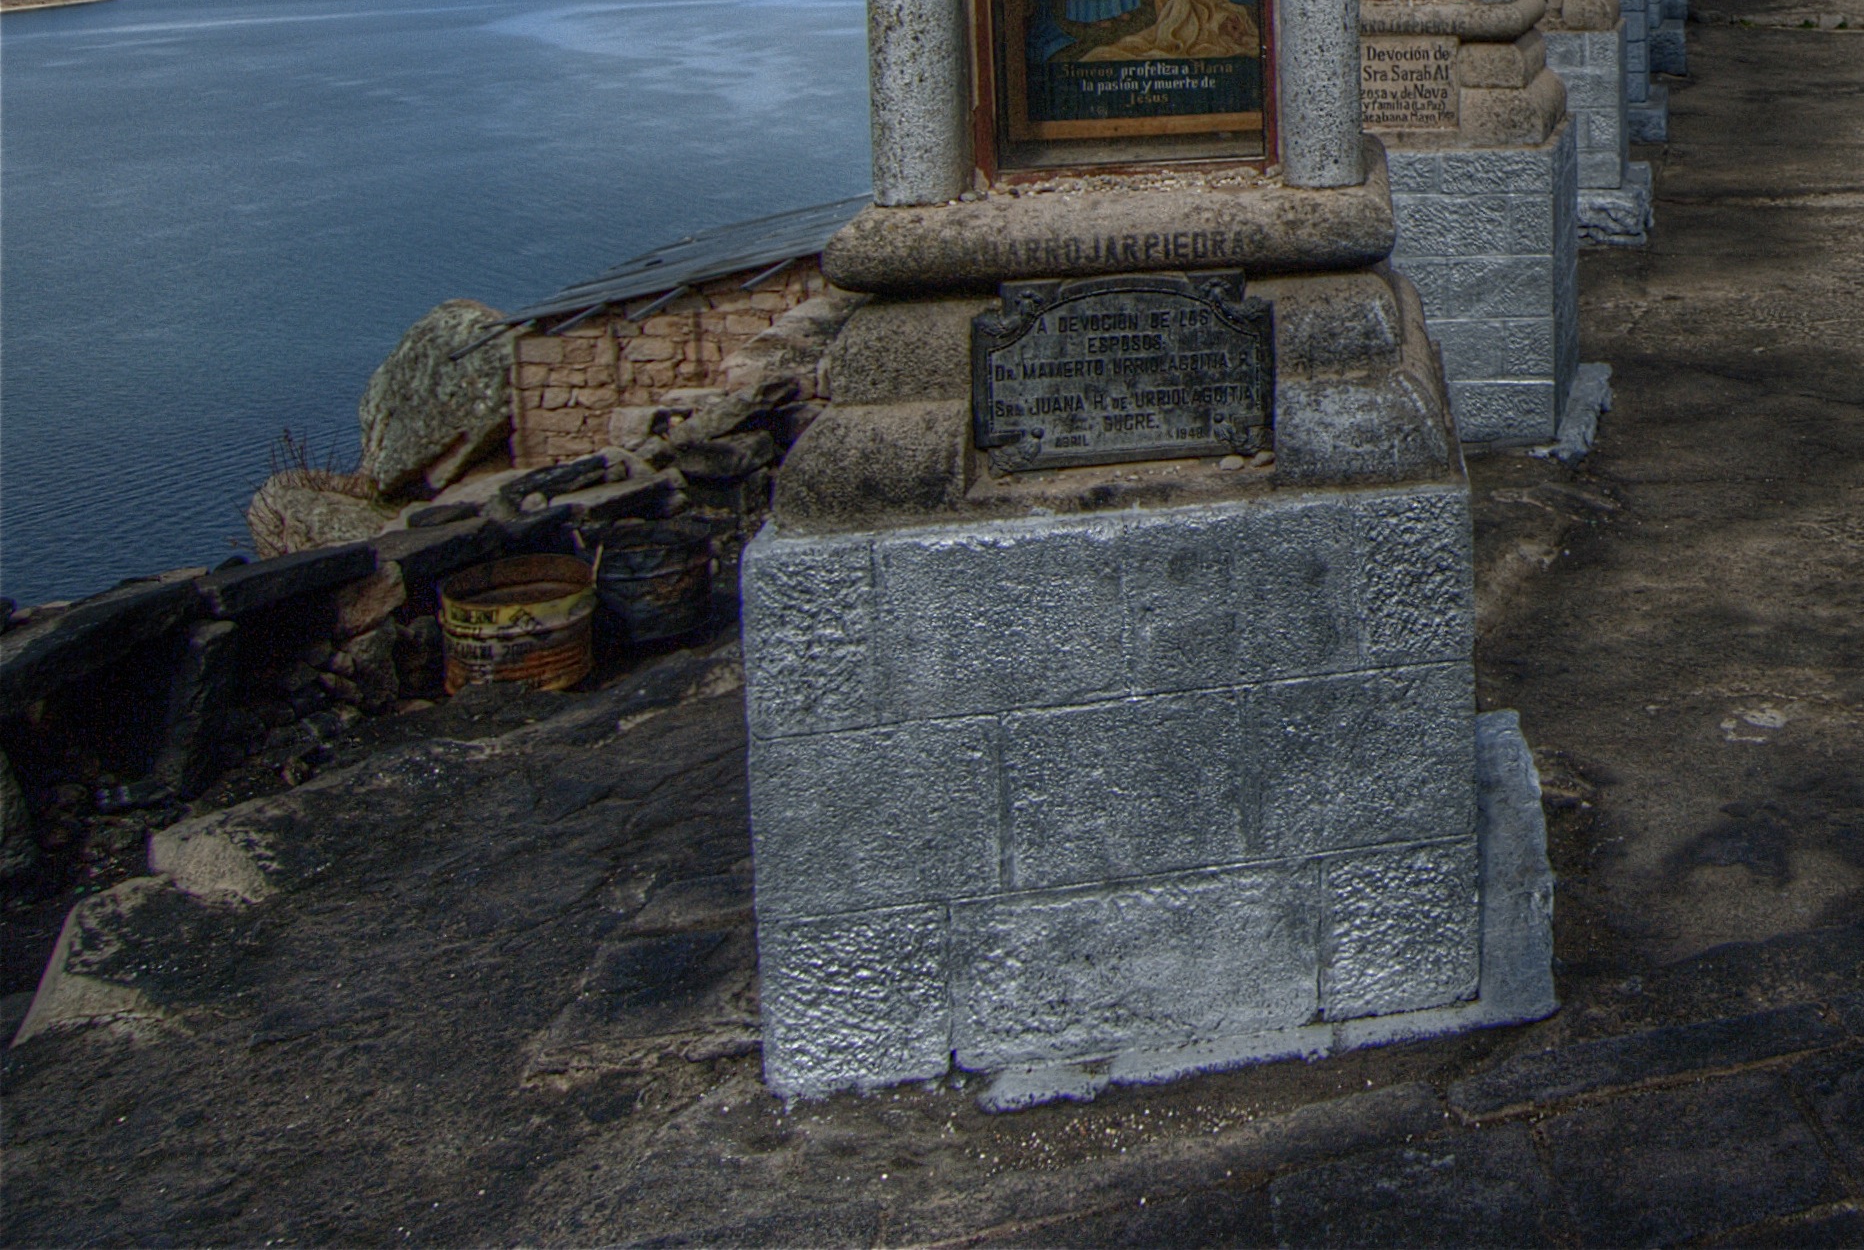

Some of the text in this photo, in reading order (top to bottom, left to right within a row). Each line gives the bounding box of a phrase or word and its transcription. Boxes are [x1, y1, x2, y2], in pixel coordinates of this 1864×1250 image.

[1366, 44, 1450, 61] Devoción de
[1120, 60, 1180, 80] profetiza
[1181, 65, 1190, 75] a
[1363, 64, 1388, 82] Sra
[1391, 64, 1432, 82] Sarah
[1081, 75, 1217, 95] la pasión y muerte de
[1414, 83, 1448, 99] Nava
[1371, 98, 1410, 111] familia
[1150, 310, 1170, 329] DE
[1179, 308, 1209, 327] LOS
[1023, 358, 1104, 380] MAMERTO
[1029, 394, 1085, 416] JUANA
[1055, 435, 1090, 448] ABRIL
